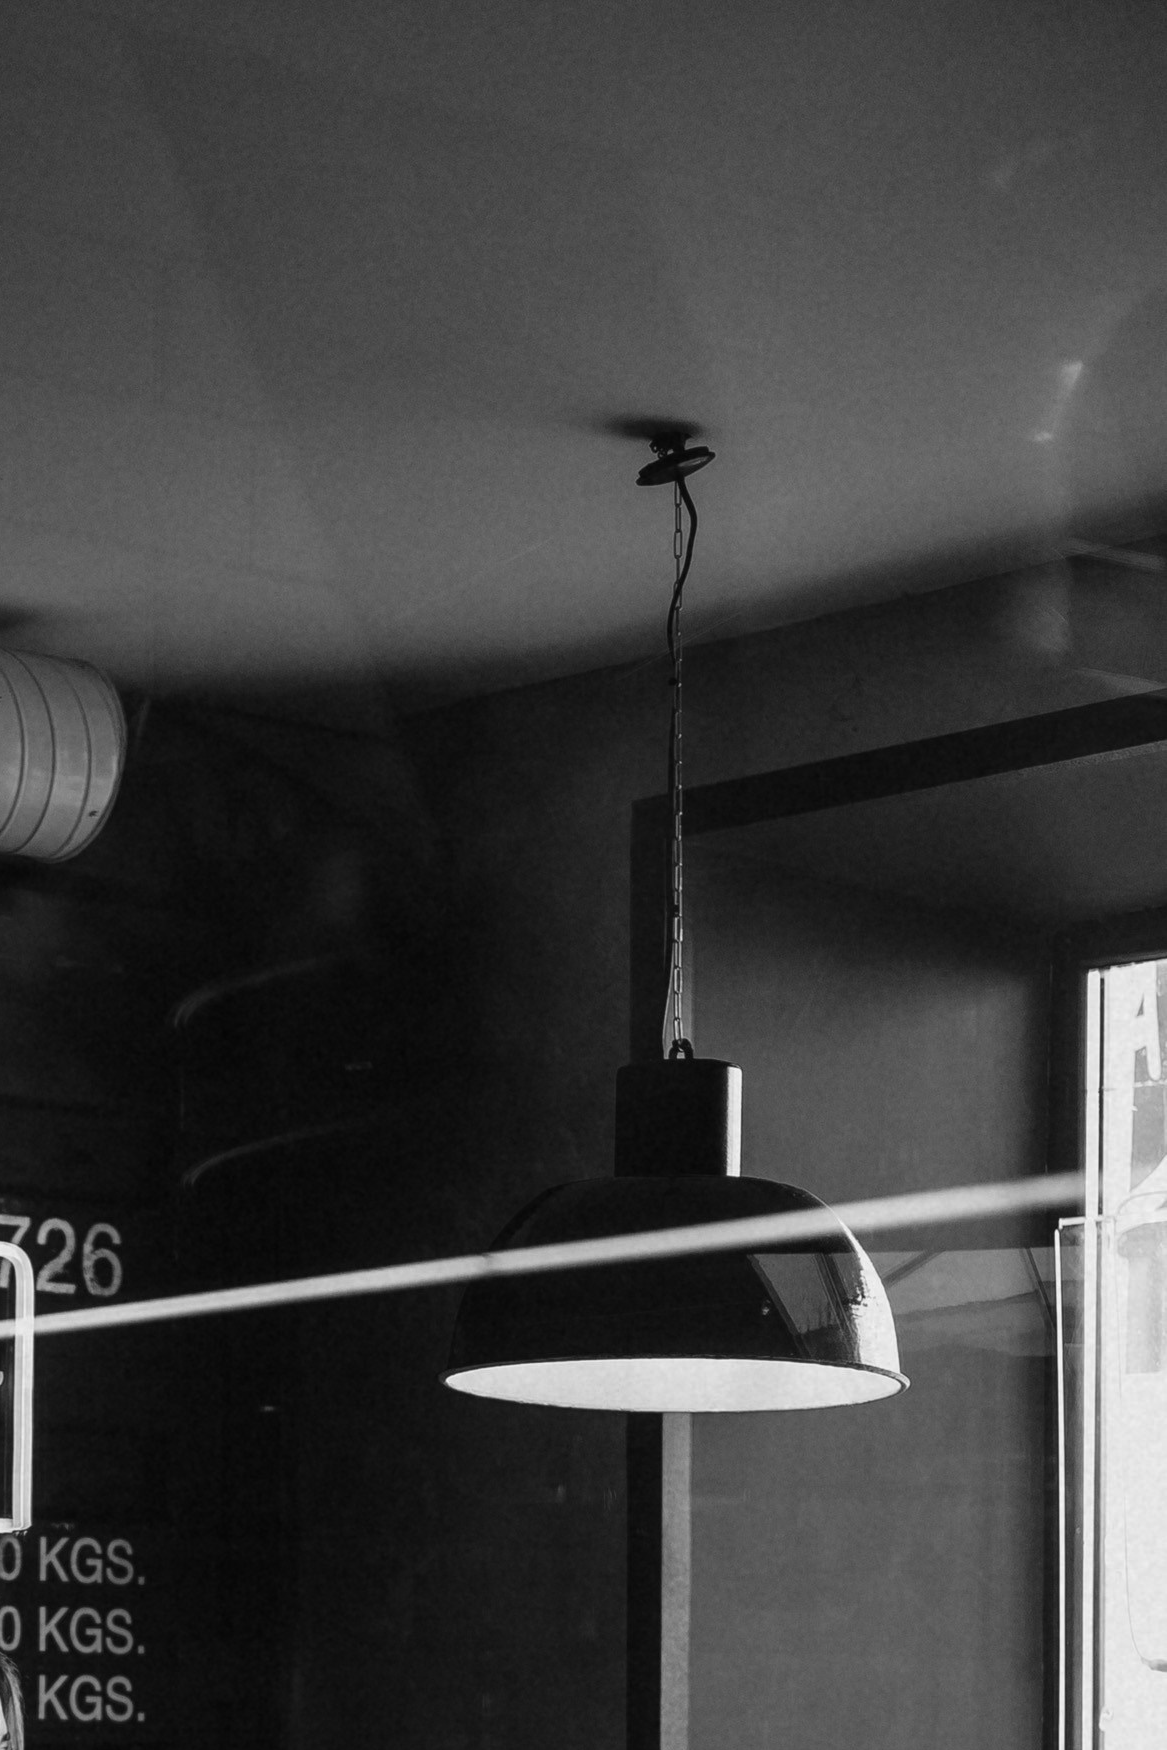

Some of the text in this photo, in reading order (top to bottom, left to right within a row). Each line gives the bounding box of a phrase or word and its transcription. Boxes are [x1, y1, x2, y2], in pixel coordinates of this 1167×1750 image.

[37, 1536, 146, 1586] KGS.
[37, 1605, 146, 1655] KGS.
[37, 1674, 146, 1723] KGS.
